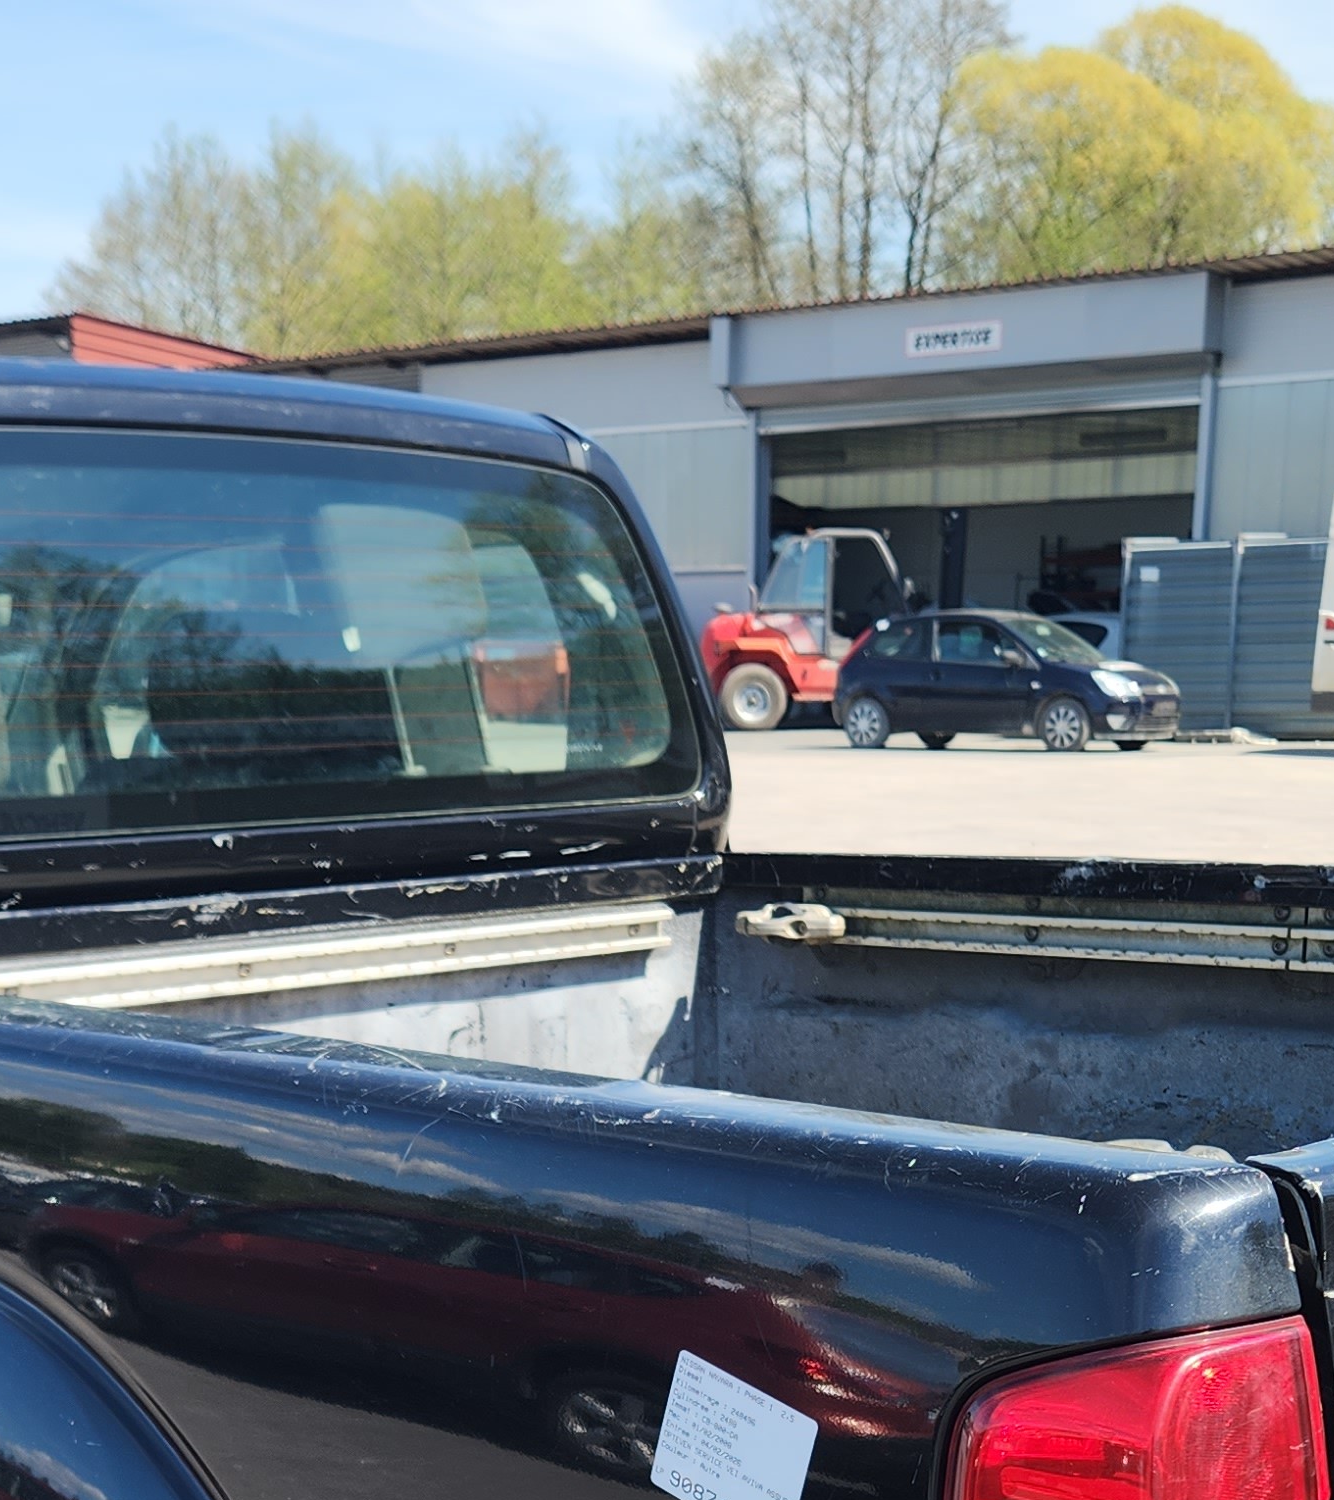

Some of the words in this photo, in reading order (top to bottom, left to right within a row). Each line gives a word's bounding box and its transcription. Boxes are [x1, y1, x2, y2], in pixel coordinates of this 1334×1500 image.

[915, 327, 991, 350] EXPERTISE
[678, 1364, 702, 1384] Diesel
[671, 1398, 690, 1414] Immat
[665, 1419, 690, 1438] Entree
[699, 1461, 720, 1479] Autre
